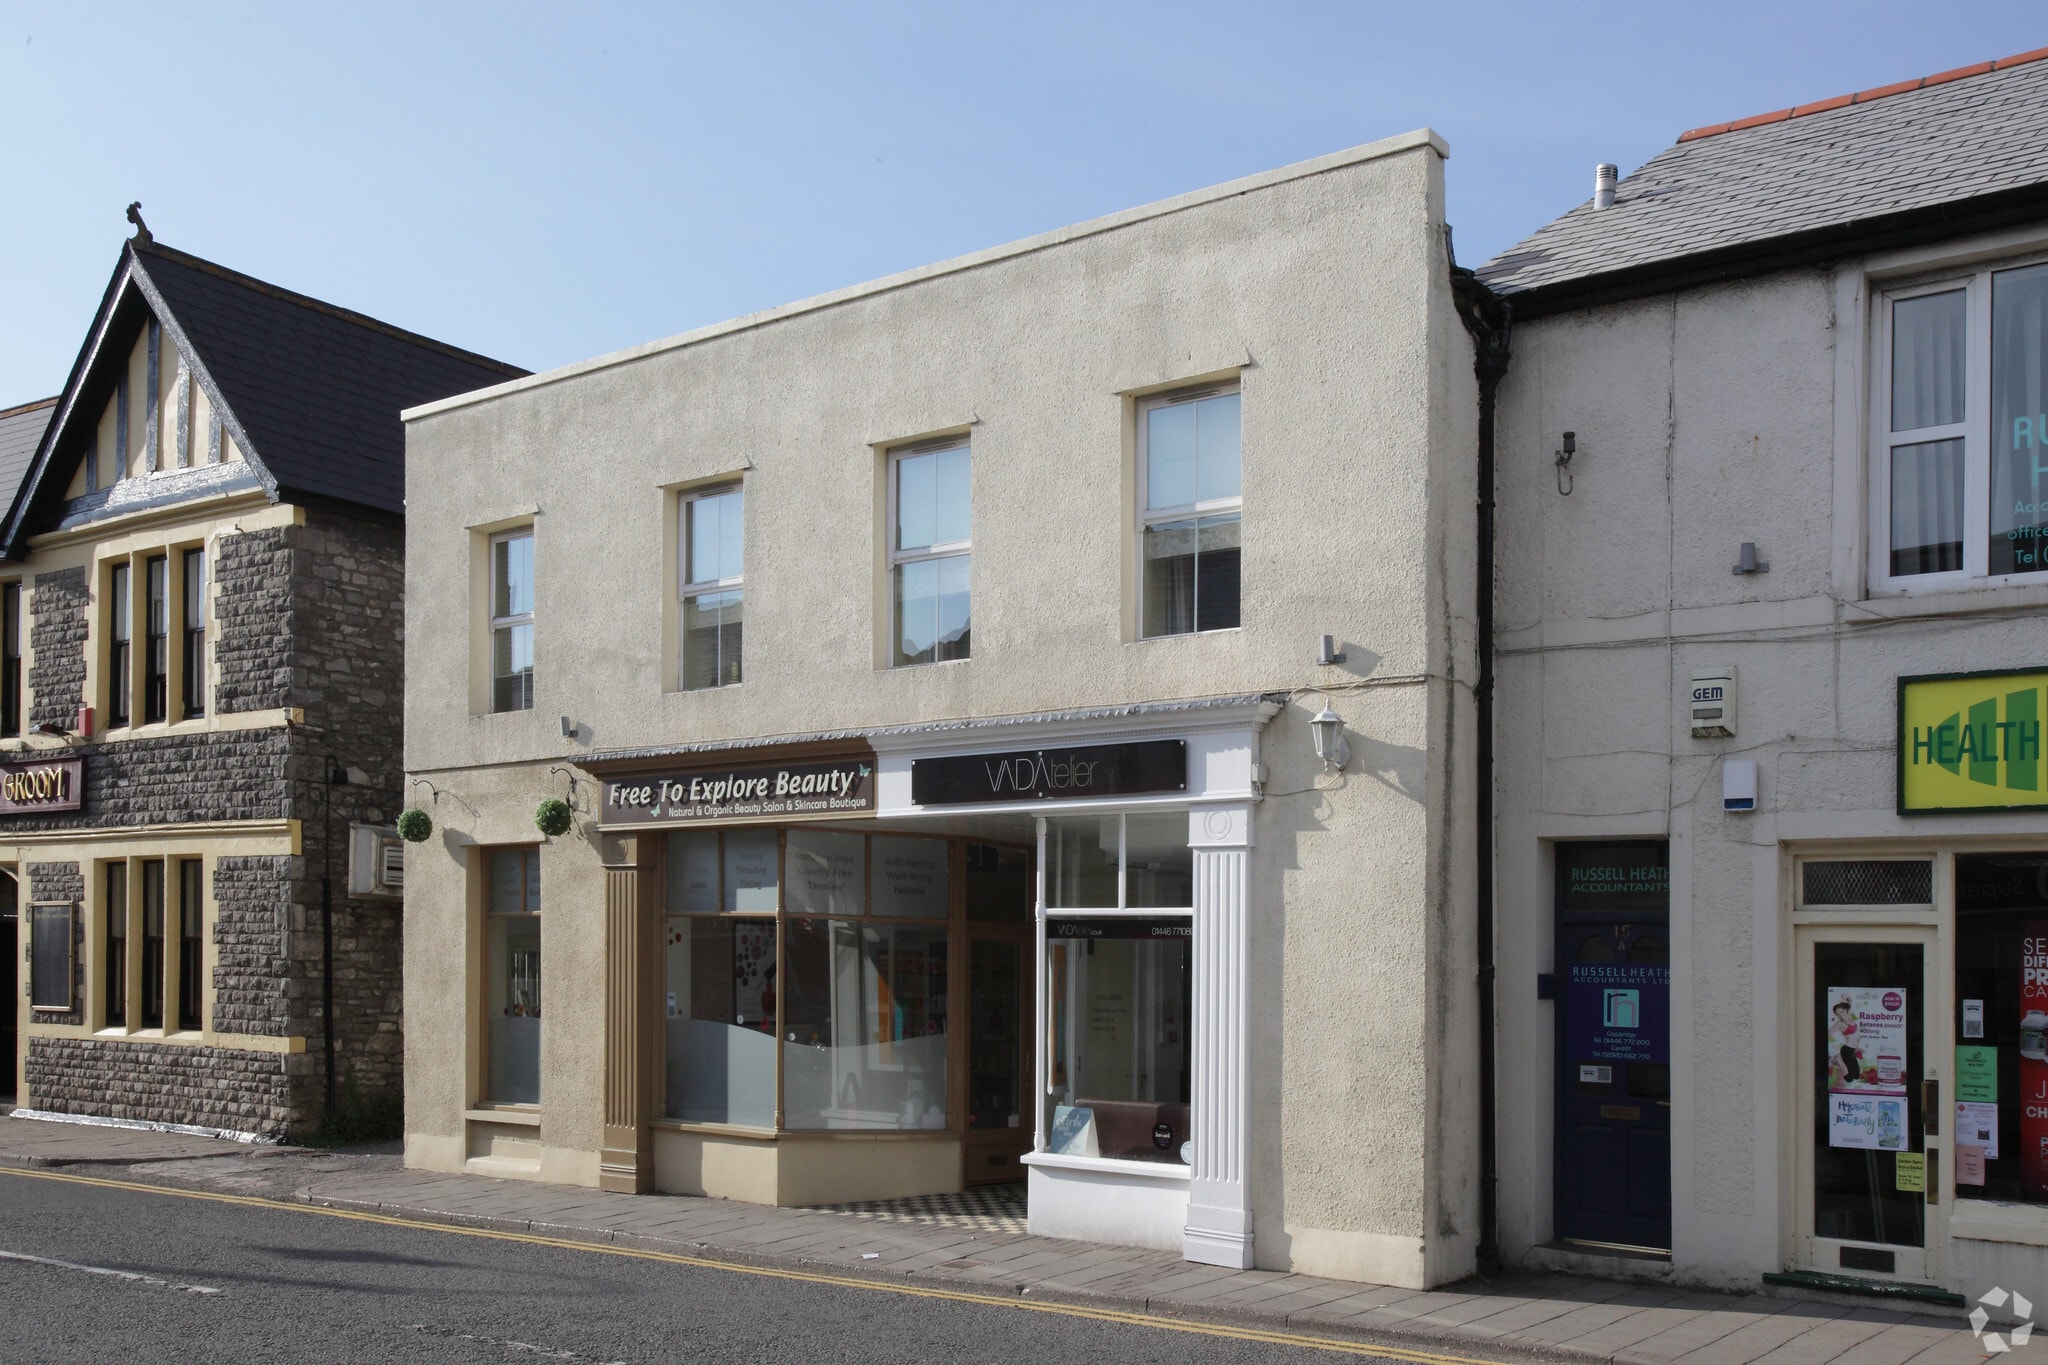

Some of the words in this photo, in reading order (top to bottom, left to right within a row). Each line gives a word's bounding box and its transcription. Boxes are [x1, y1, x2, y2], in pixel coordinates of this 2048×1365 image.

[2015, 547, 2037, 565] Tel
[1692, 686, 1723, 700] GEM
[1913, 720, 2040, 765] HEALTH
[3, 766, 63, 801] GROOM
[609, 783, 651, 806] Free
[659, 779, 683, 803] To
[690, 773, 768, 805] Explore
[776, 769, 855, 797] Beauty
[669, 806, 694, 818] Natural
[696, 805, 703, 816] &
[704, 803, 733, 818] Organic
[734, 803, 760, 815] Beauty
[763, 801, 784, 812] Salon
[786, 800, 793, 811] &
[795, 798, 827, 811] Skincare
[829, 797, 867, 809] Boutique
[1571, 866, 1625, 881] RUSSELL
[1571, 882, 1670, 893] ACCOUNTANTS
[1612, 924, 1631, 938] 15
[1572, 966, 1627, 977] RUSSELL
[1573, 976, 1647, 985] ACCOUNTANTS
[1859, 1011, 1904, 1022] Raspberry
